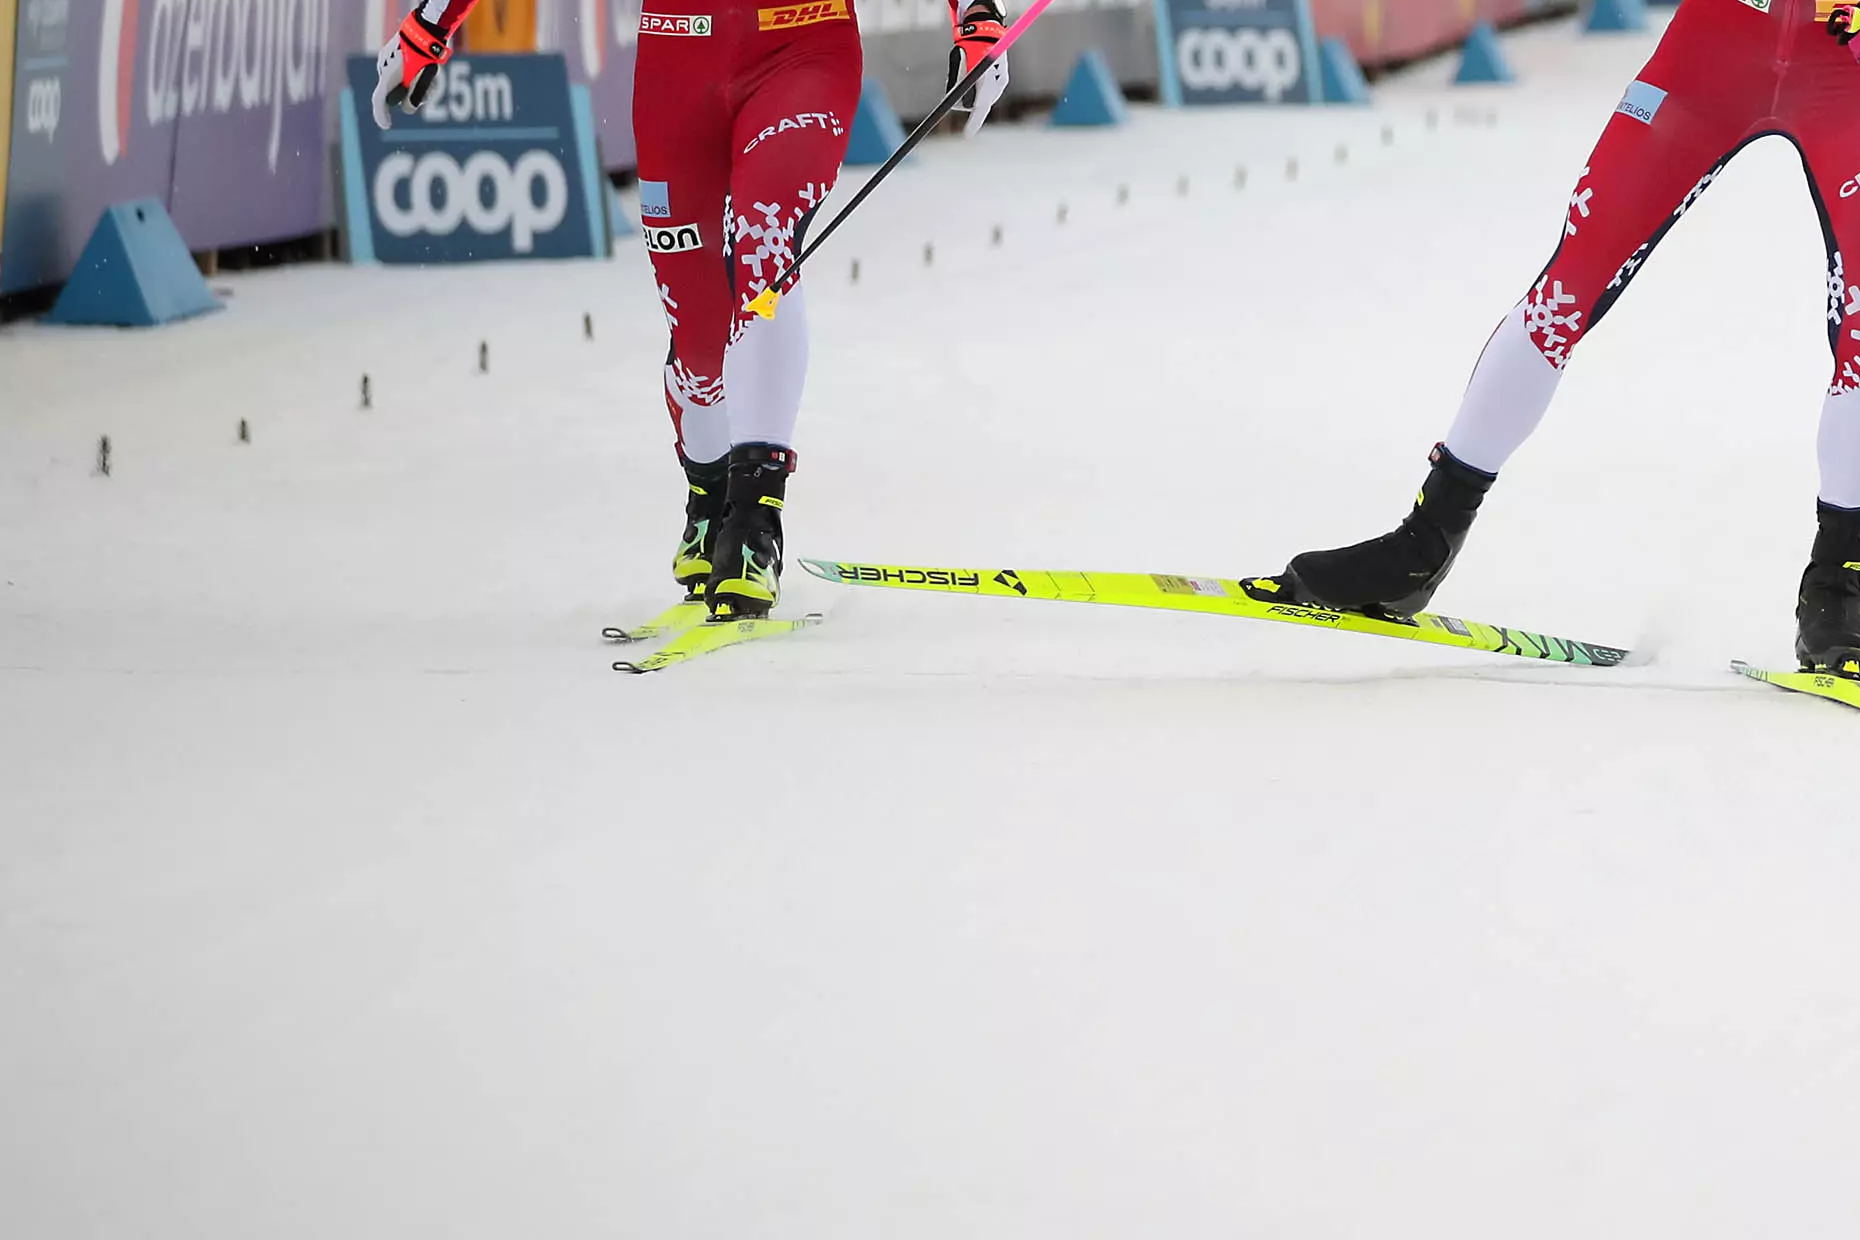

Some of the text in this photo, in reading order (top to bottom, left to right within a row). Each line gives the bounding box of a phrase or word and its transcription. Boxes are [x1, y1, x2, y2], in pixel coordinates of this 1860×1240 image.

[642, 17, 689, 32] SPAR
[771, 2, 840, 27] DHL
[1178, 27, 1300, 103] coop
[424, 62, 514, 123] 25m
[743, 113, 828, 154] CRAFT
[374, 148, 568, 254] coop
[838, 564, 980, 587] FISCHER
[1266, 604, 1342, 624] FISCHER
